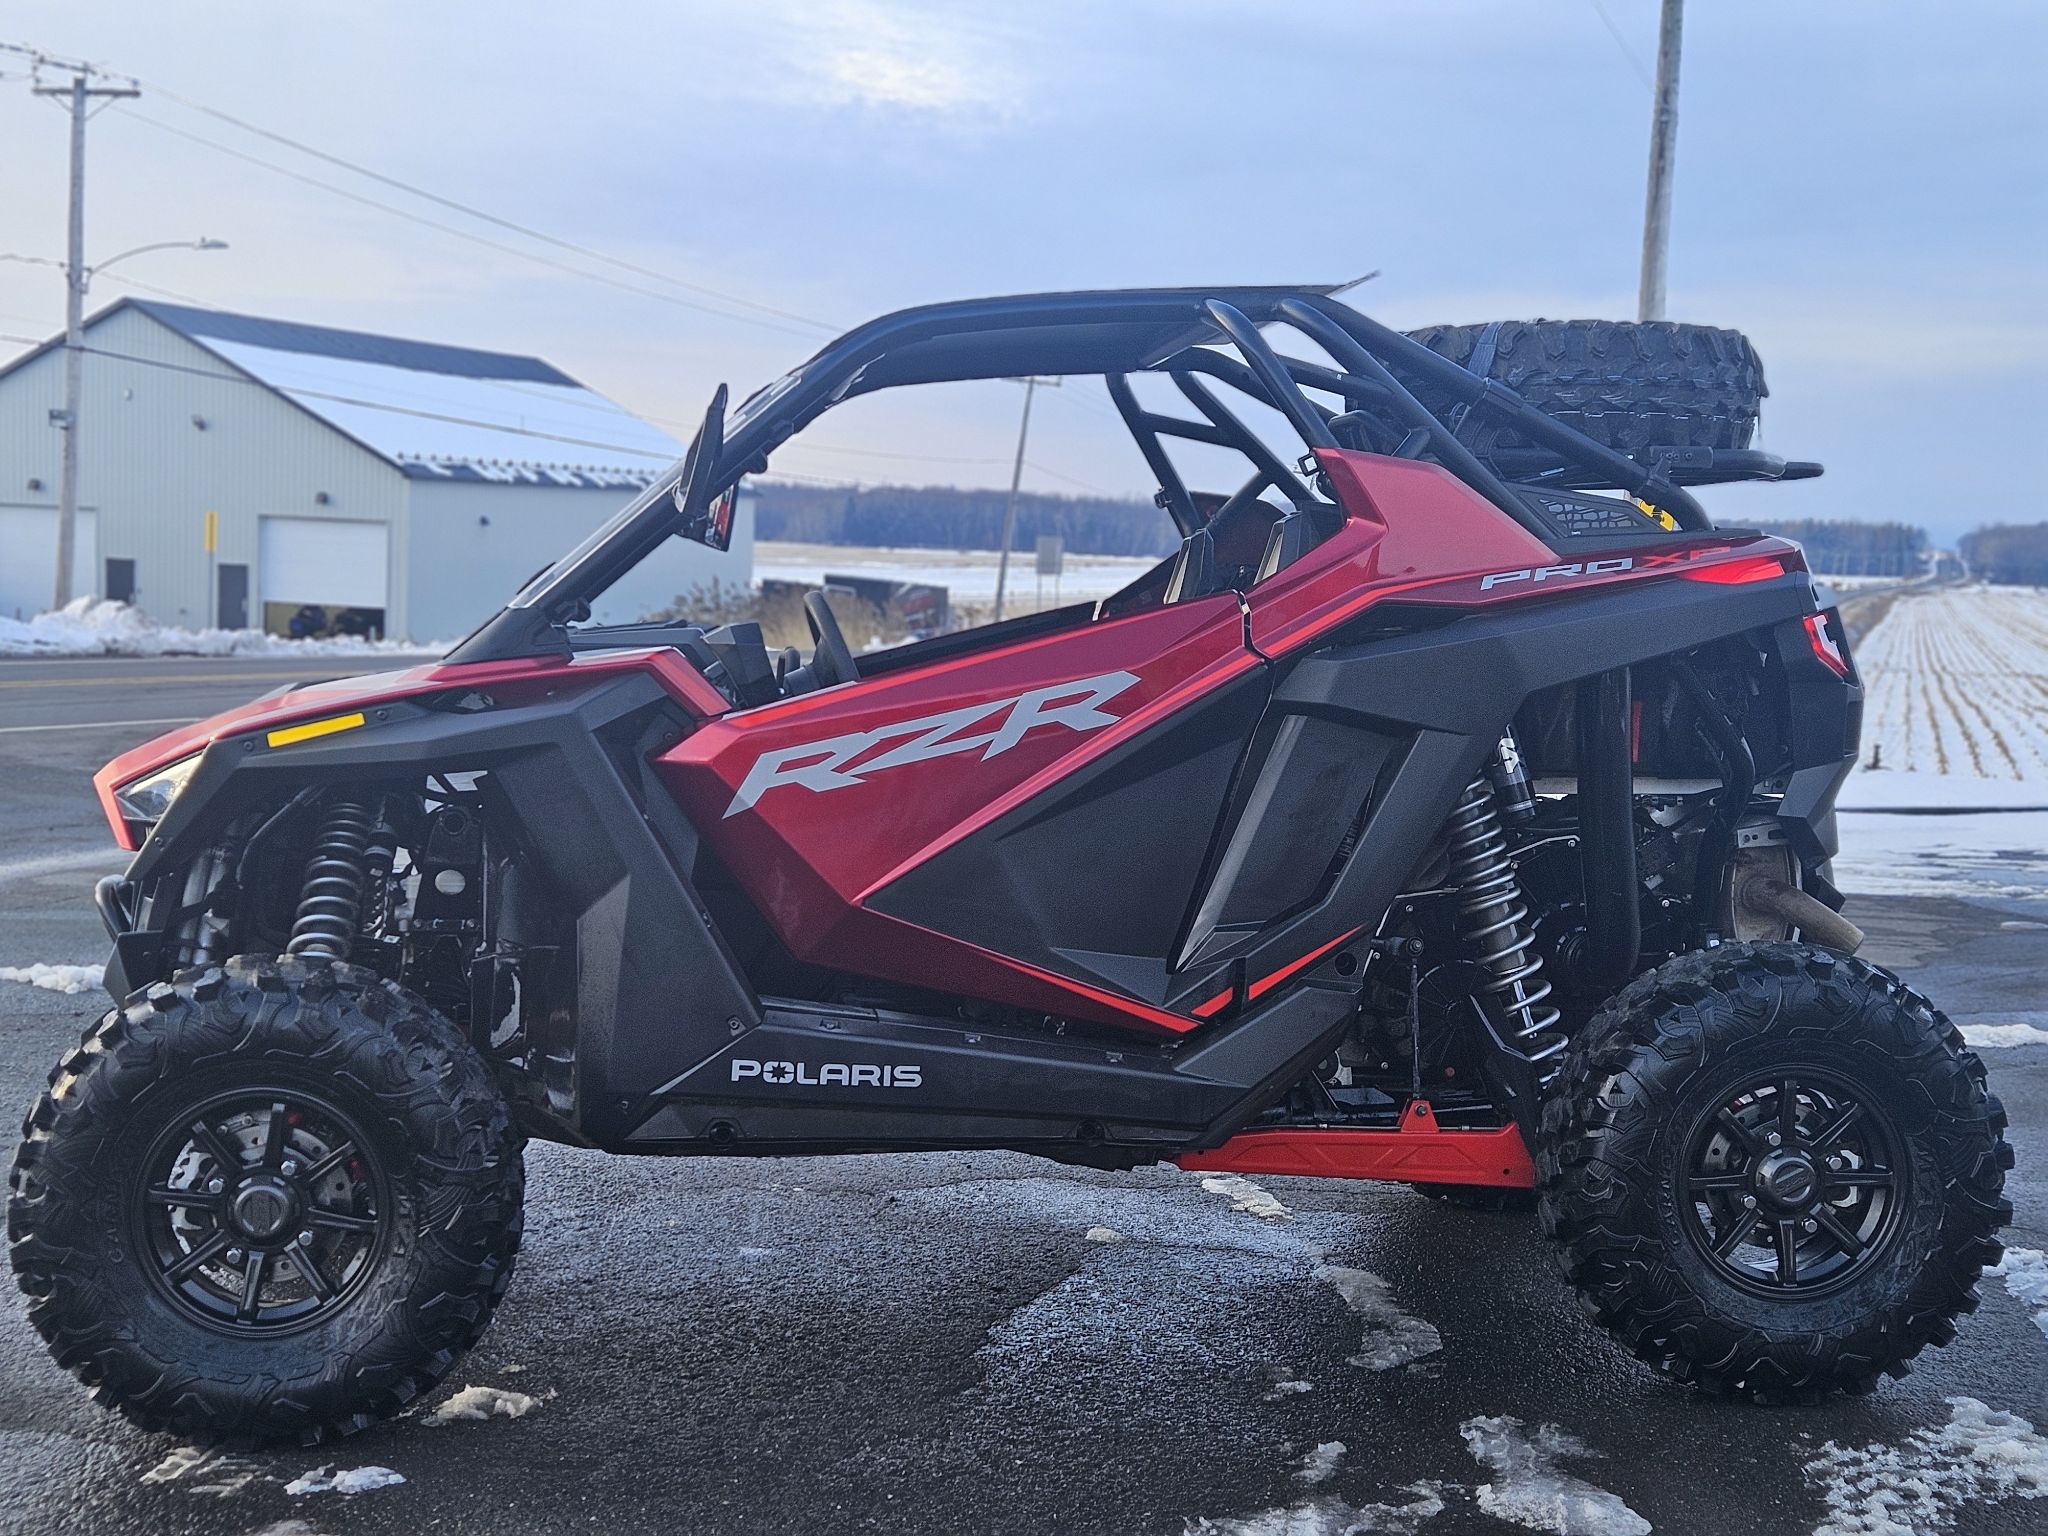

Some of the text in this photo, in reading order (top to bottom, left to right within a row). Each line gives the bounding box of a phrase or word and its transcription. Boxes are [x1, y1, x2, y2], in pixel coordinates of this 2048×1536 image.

[1480, 546, 1731, 590] PRO XP
[722, 670, 1142, 820] RZR
[731, 1059, 923, 1088] POLARIS
